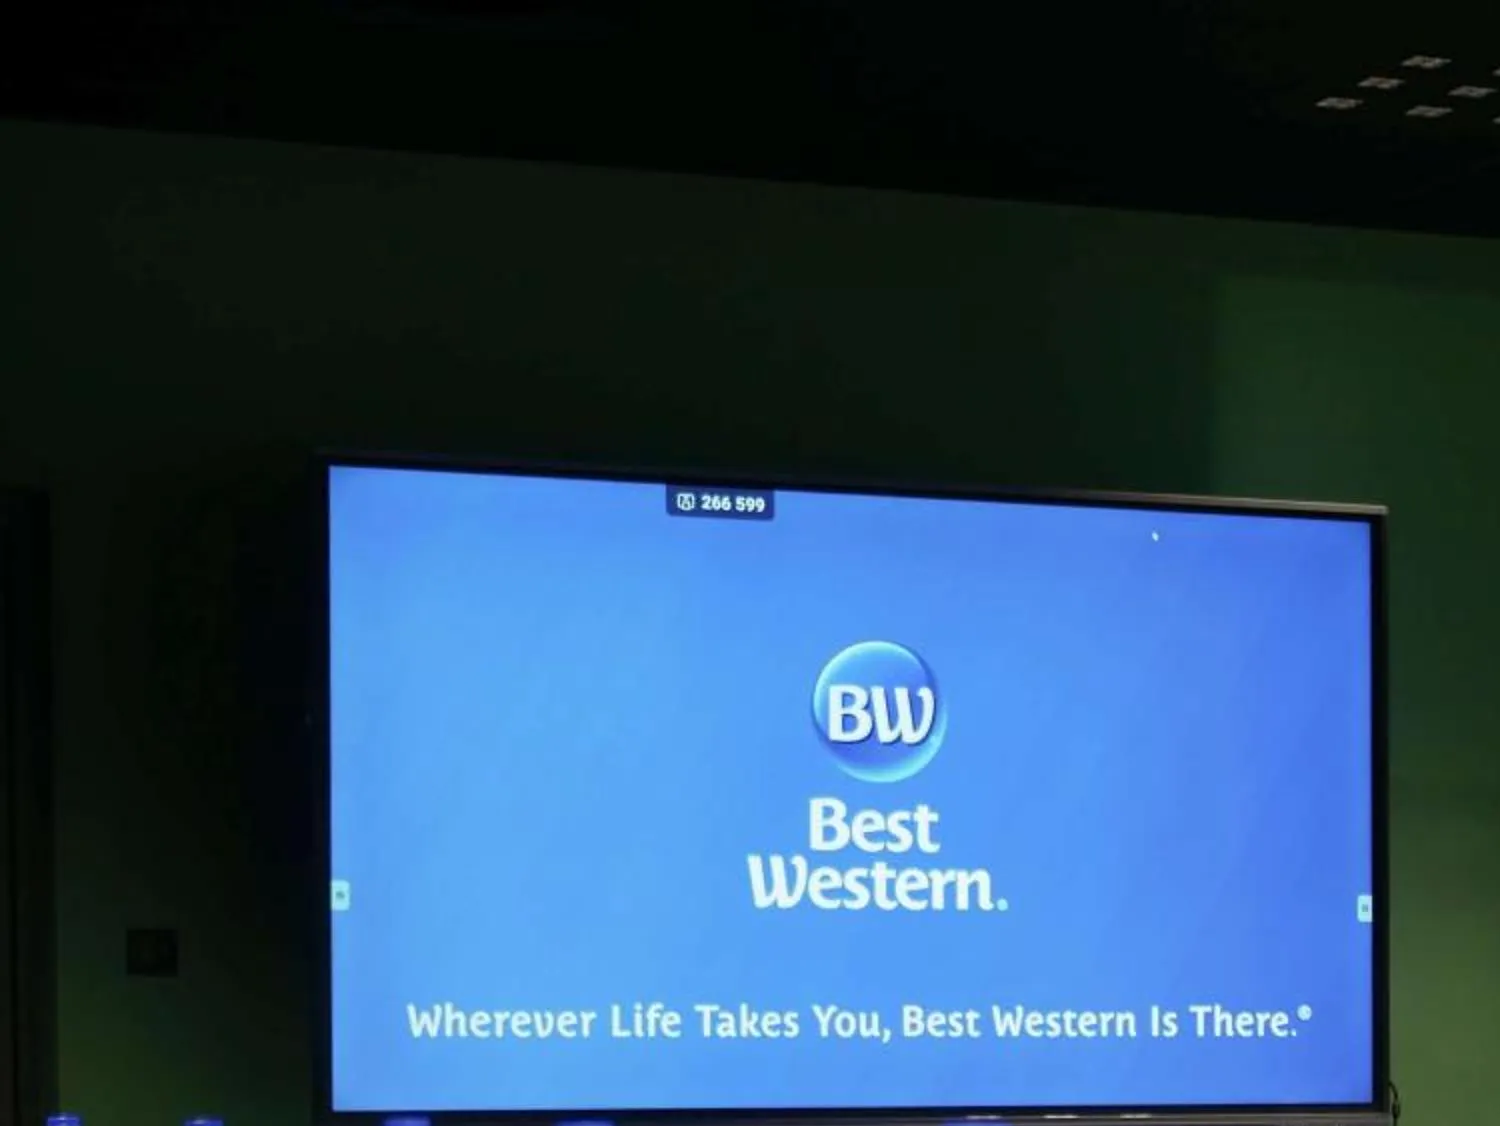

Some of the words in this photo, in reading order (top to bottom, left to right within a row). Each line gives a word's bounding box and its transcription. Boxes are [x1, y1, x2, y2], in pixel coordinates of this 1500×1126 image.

[701, 494, 732, 511] 266
[735, 496, 765, 513] 599
[827, 684, 935, 744] BW
[809, 797, 941, 853] Best
[406, 1003, 597, 1039] Wherever
[611, 1002, 682, 1039] Life
[694, 1003, 800, 1039] Takes
[812, 1004, 892, 1043] You,
[902, 1004, 981, 1038] Best
[991, 1004, 1137, 1038] Western
[1151, 1004, 1178, 1038] Is
